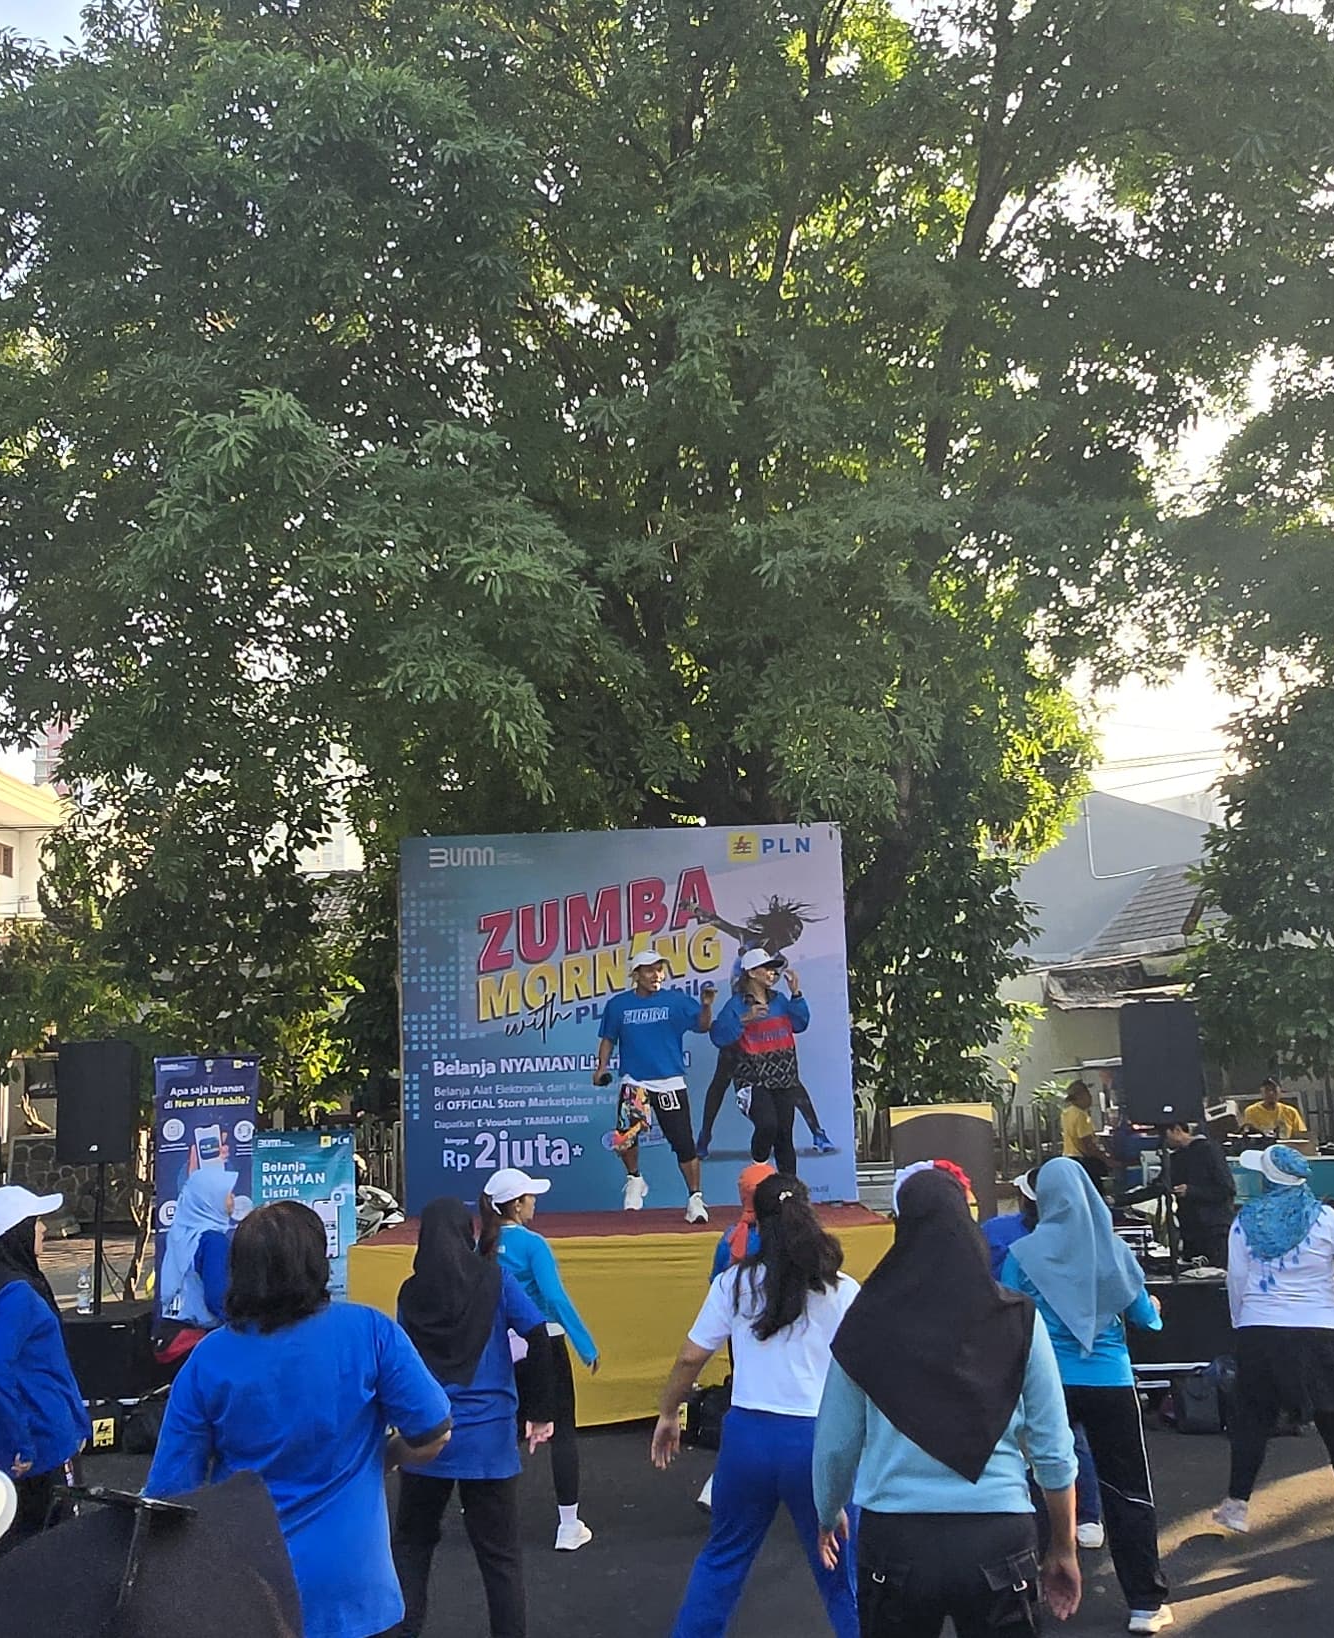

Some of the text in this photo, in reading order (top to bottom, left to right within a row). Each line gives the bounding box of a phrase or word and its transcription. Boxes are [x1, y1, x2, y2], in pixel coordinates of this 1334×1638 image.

[762, 837, 810, 854] PLN
[478, 866, 717, 974] ZUMBA
[504, 991, 573, 1044] with
[433, 1059, 496, 1078] Belanja
[500, 1056, 576, 1073] NYAMAN
[170, 1084, 244, 1098] Apa saja layanan
[434, 1086, 470, 1098] Belanja
[473, 1085, 493, 1095] Alat
[495, 1083, 545, 1095] Elektronik
[164, 1096, 251, 1110] di New PLN Mobile?
[434, 1100, 444, 1111] di
[447, 1099, 496, 1111] OFFICIAL
[498, 1098, 526, 1109] Store
[528, 1096, 593, 1108] Marketplace
[434, 1115, 589, 1130] Dapatkan E-Voucher TAMBAH DAYA
[262, 1161, 306, 1173] Belanja
[443, 1150, 471, 1172] Rp
[262, 1173, 325, 1186] NYAMAN
[262, 1187, 300, 1199] Listrik
